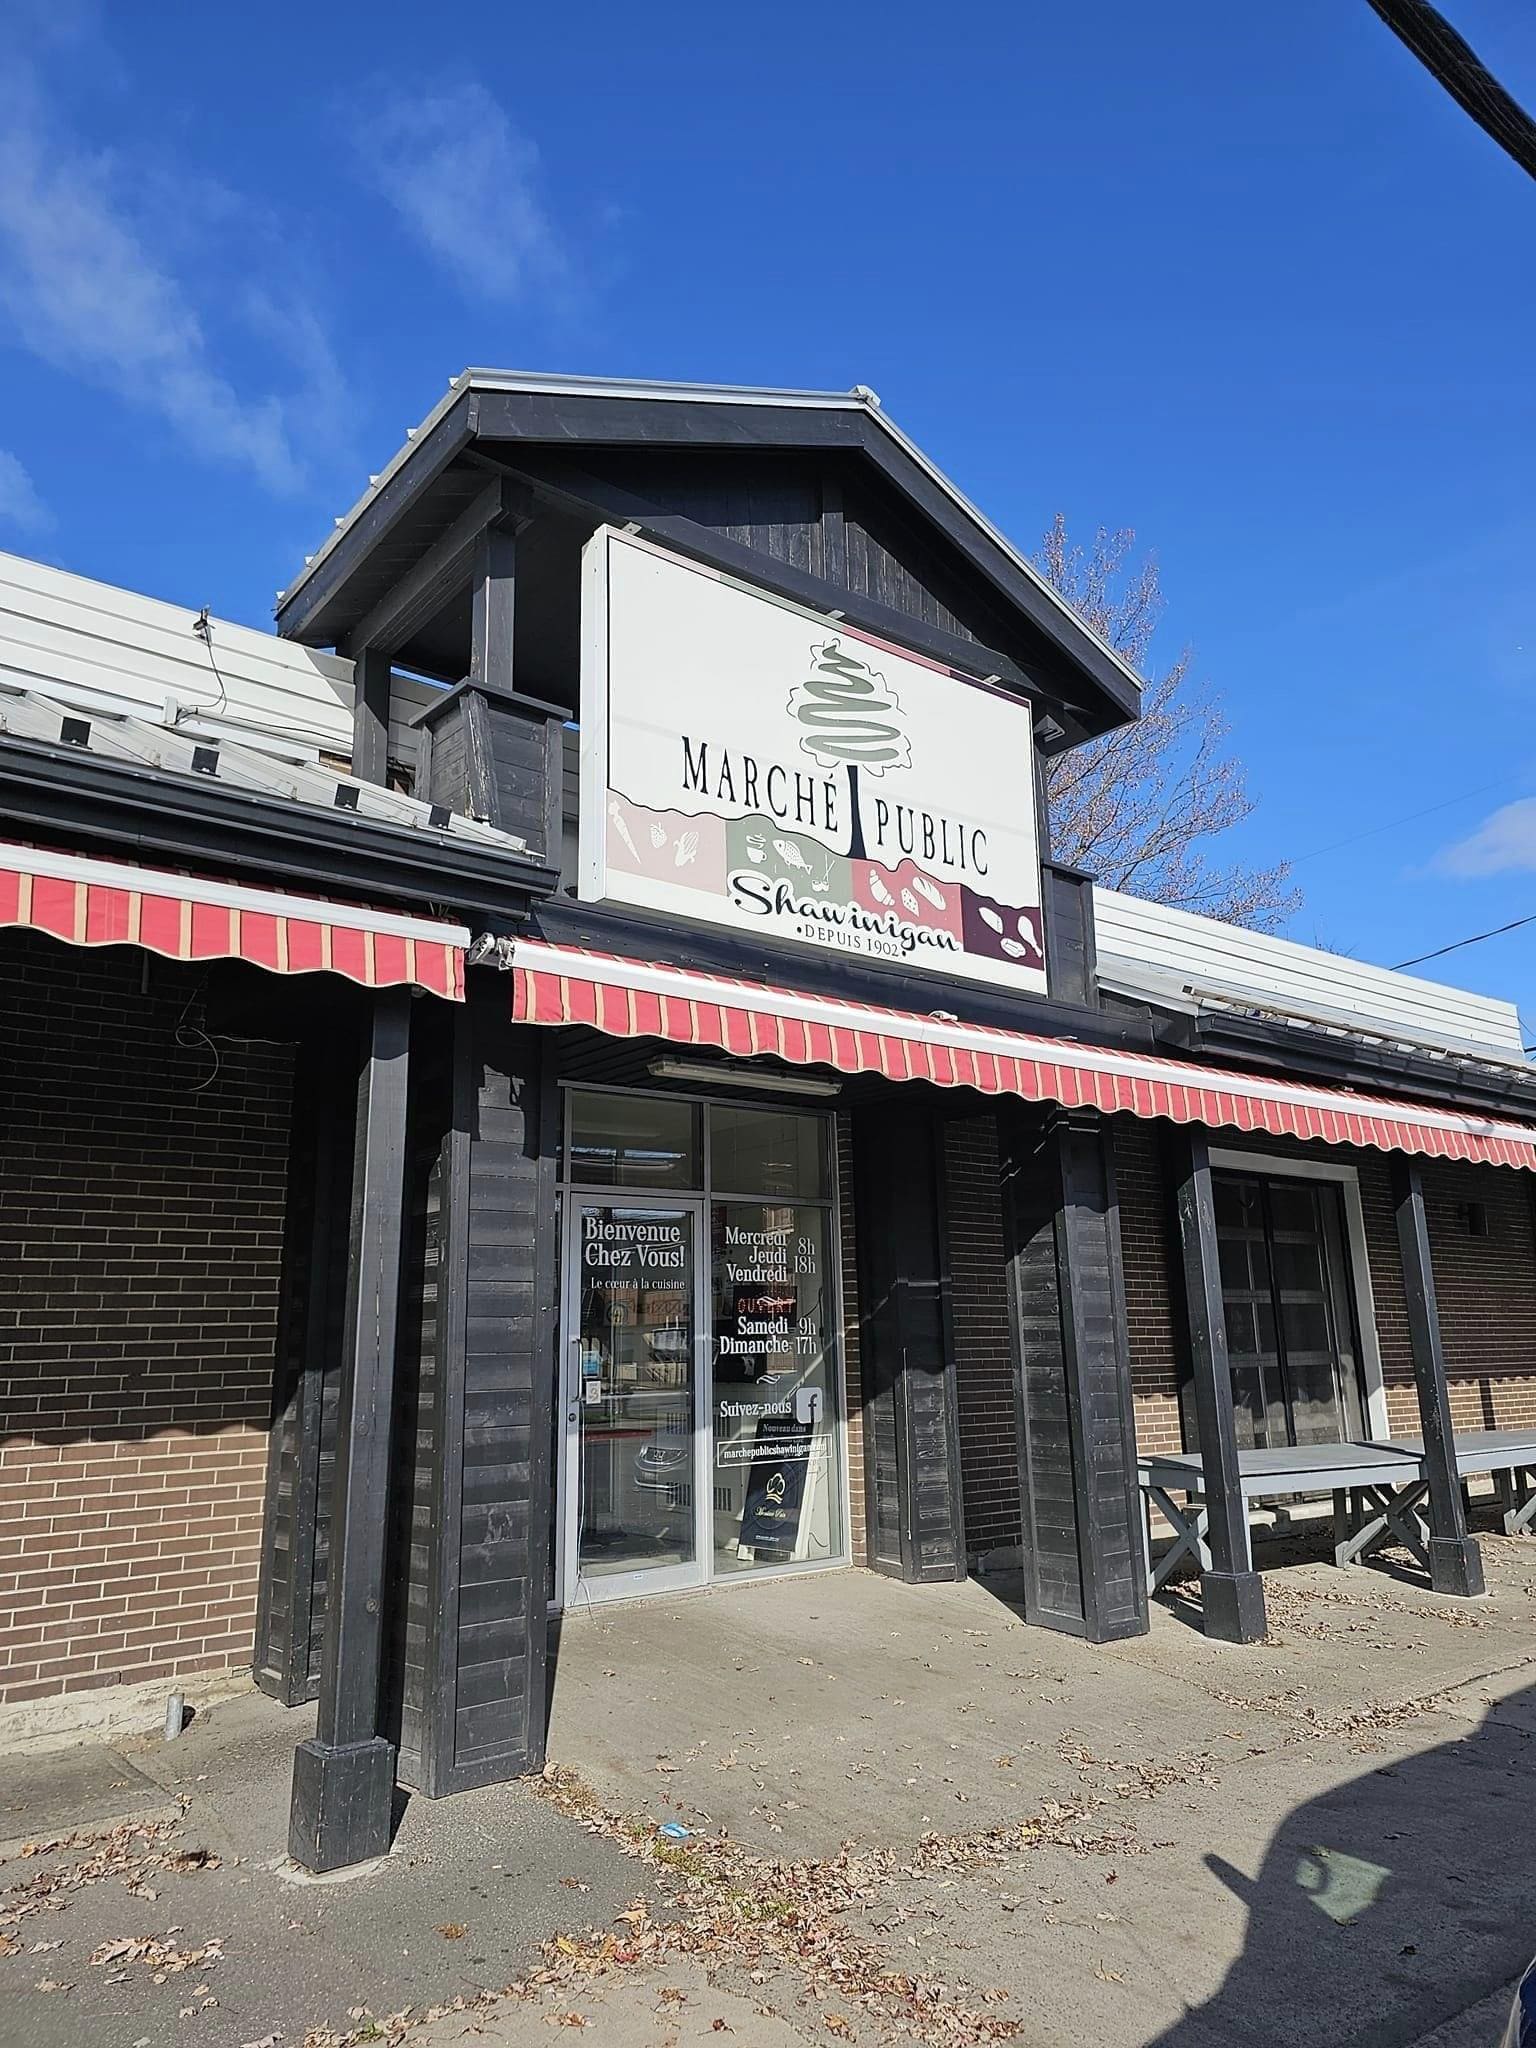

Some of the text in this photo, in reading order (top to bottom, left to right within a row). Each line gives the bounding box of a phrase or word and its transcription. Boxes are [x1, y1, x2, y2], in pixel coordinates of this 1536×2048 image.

[682, 736, 989, 876] MARCHÉ PUBLIC
[733, 875, 960, 952] Shawinigan
[804, 924, 899, 957] DEPUIS 1902
[585, 1216, 681, 1242] Bienvenue
[725, 1226, 787, 1246] Mercredi
[585, 1242, 685, 1267] Chez Vous!
[749, 1245, 787, 1264] Jeudi
[798, 1237, 815, 1256] 8h
[726, 1263, 787, 1282] Vendredi
[794, 1255, 816, 1274] 18h
[591, 1276, 603, 1289] Le
[641, 1276, 650, 1289] la
[651, 1279, 686, 1290] cuisine
[737, 1316, 789, 1335] Samedi
[799, 1317, 816, 1335] 9h
[720, 1335, 789, 1354] Dimanche
[796, 1336, 817, 1354] 17h
[720, 1400, 792, 1418] Suivez-nous
